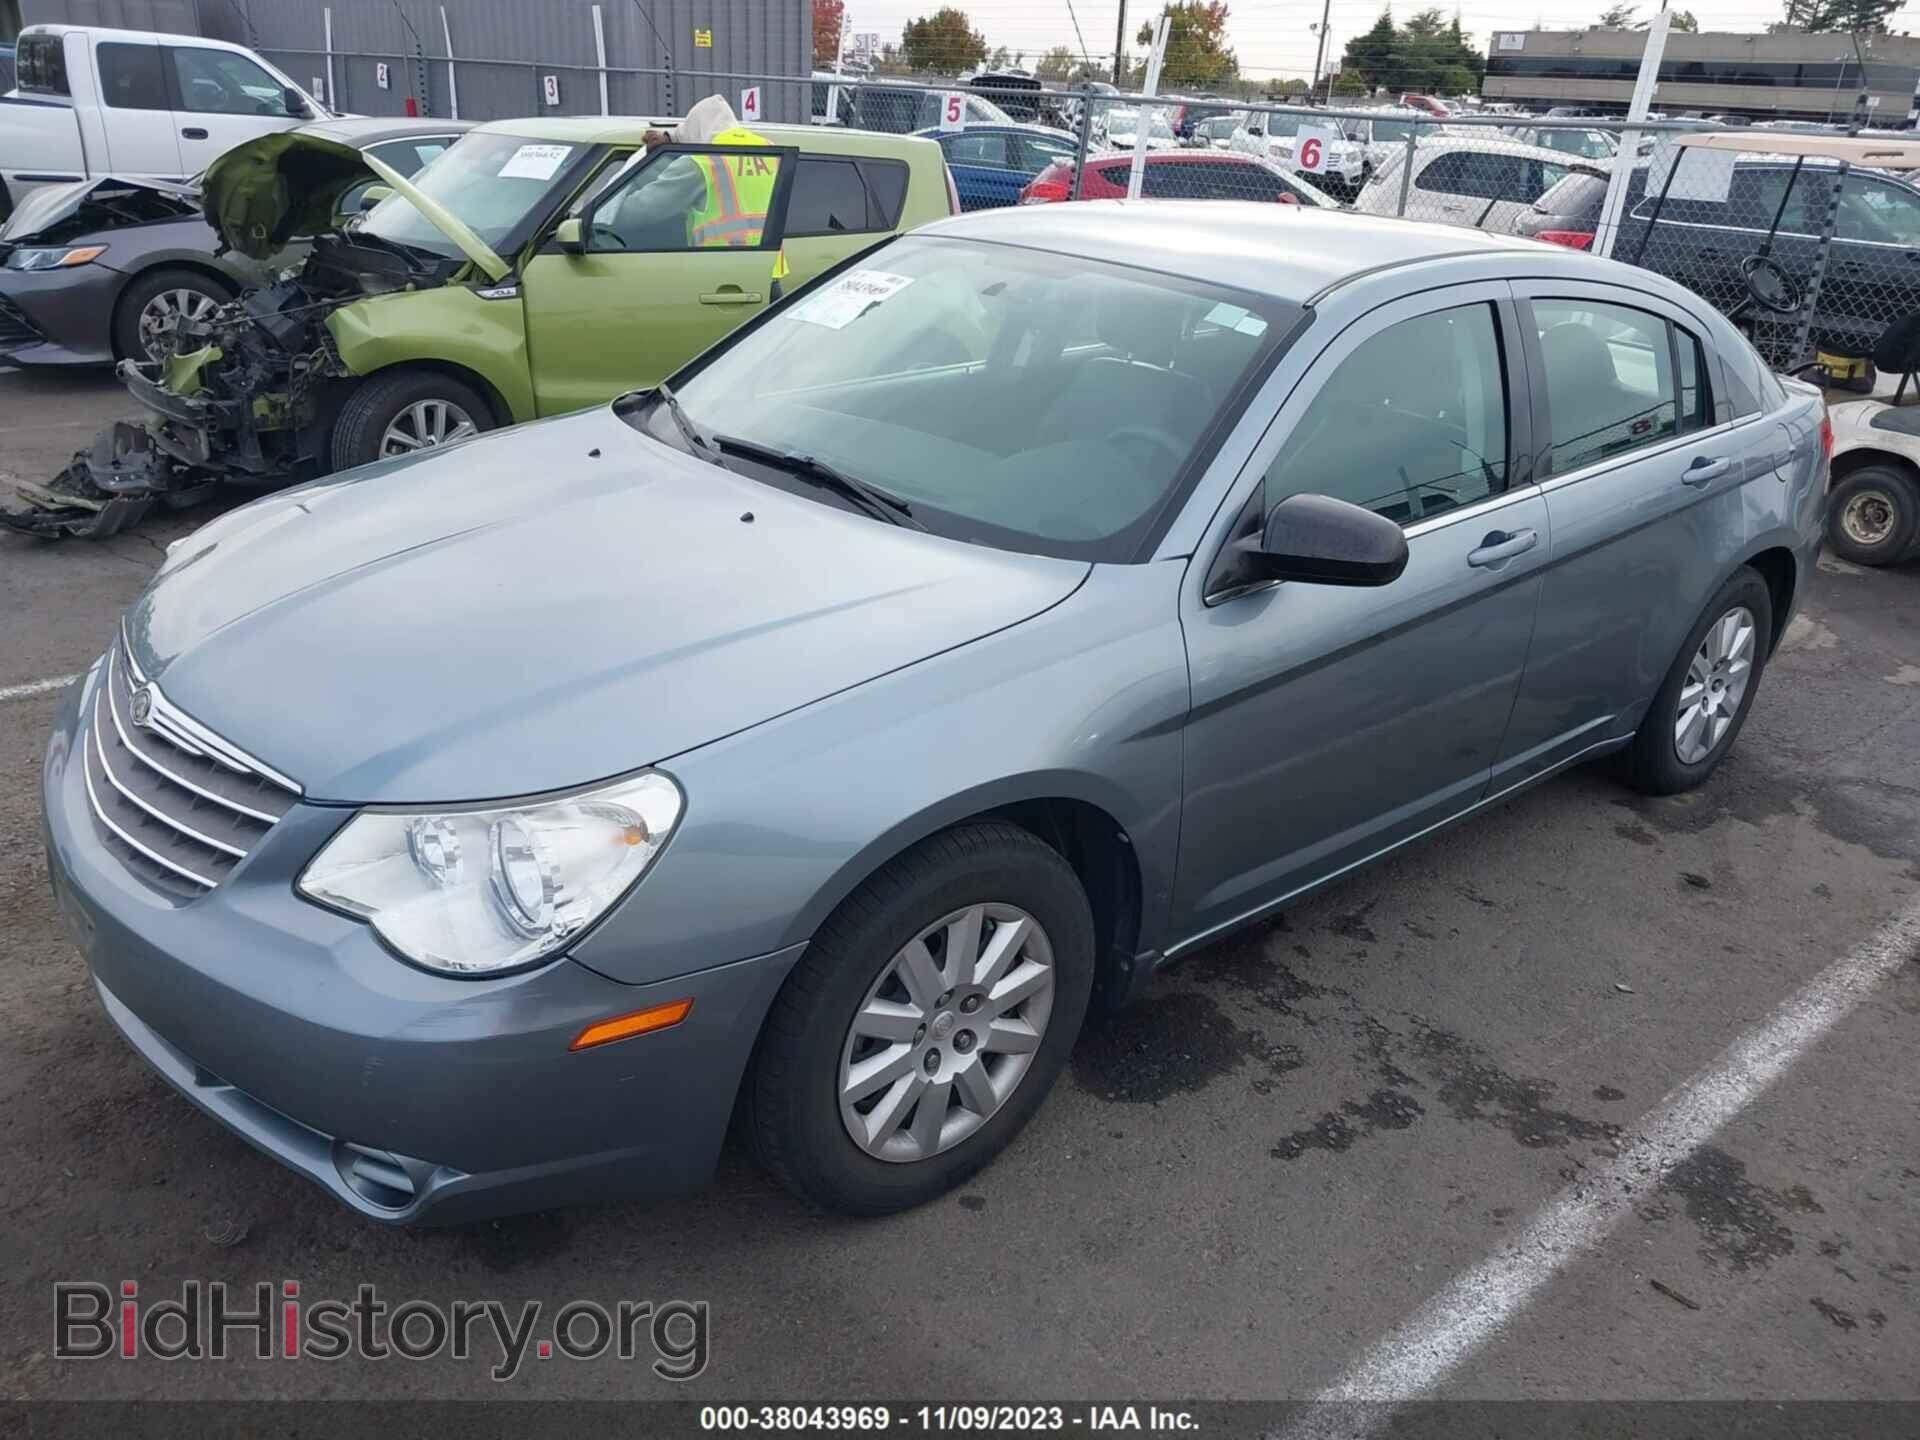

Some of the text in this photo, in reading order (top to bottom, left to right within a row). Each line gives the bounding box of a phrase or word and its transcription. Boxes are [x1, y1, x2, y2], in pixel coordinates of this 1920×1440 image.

[547, 78, 555, 97] 3
[745, 90, 756, 113] 4
[947, 97, 961, 122] 5
[1301, 138, 1322, 169] 6
